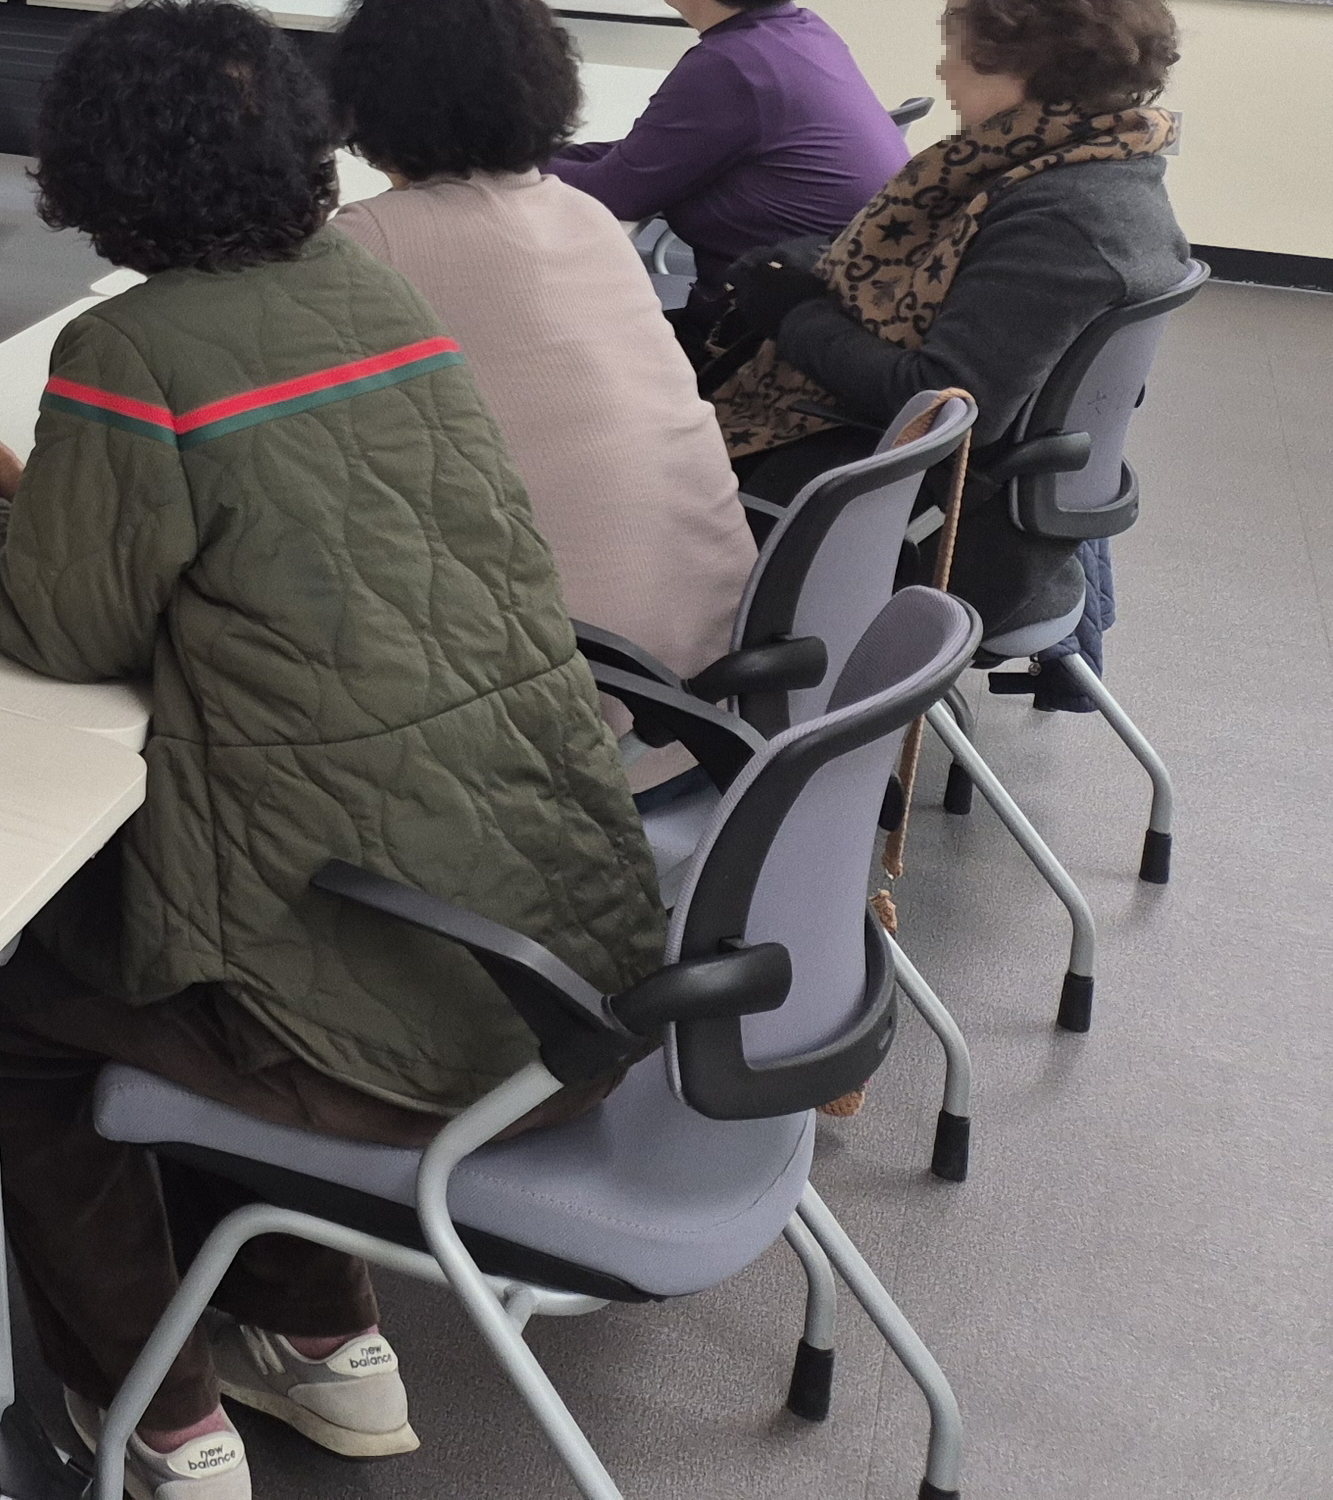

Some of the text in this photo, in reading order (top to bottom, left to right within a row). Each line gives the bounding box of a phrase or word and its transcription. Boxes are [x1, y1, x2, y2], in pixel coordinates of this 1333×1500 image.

[360, 1345, 382, 1357] new
[188, 1449, 236, 1470] balance
[200, 1444, 224, 1460] new
